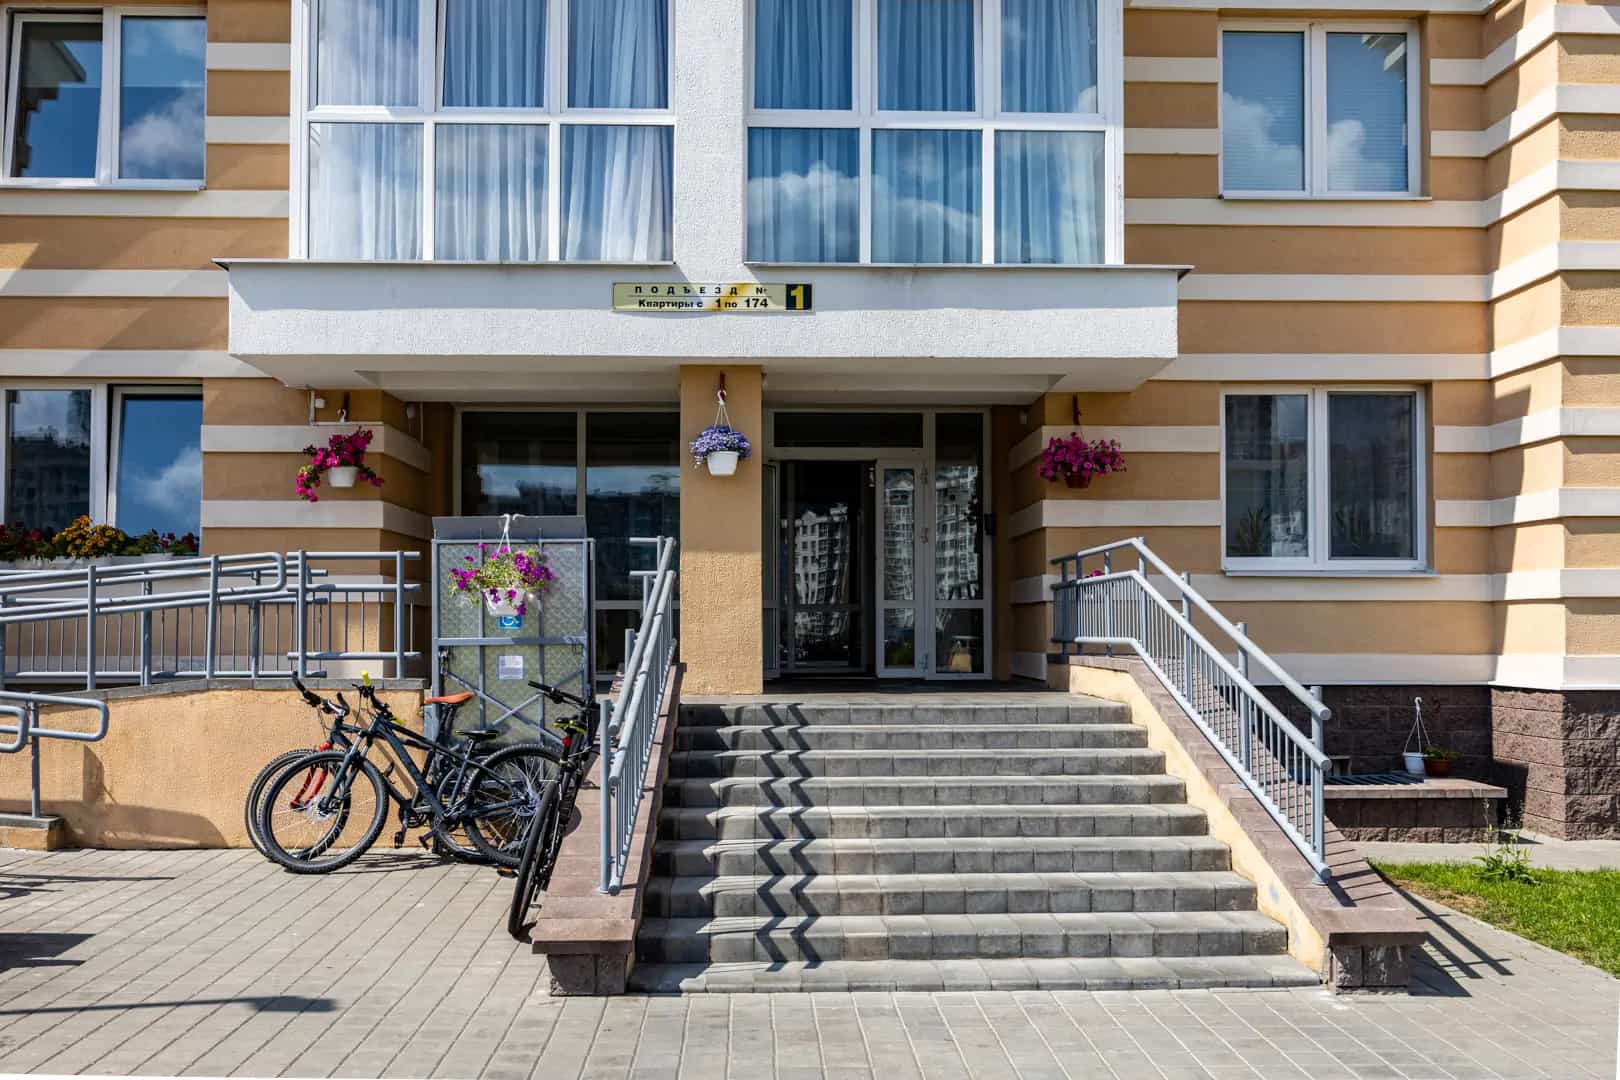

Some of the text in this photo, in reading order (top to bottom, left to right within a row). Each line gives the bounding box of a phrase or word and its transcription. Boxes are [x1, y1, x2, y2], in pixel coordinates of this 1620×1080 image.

[635, 286, 738, 296] ПОДЪЕЗД
[790, 286, 804, 309] 1
[638, 299, 694, 309] Квартиры
[715, 298, 721, 308] 1
[744, 298, 768, 308] 174
